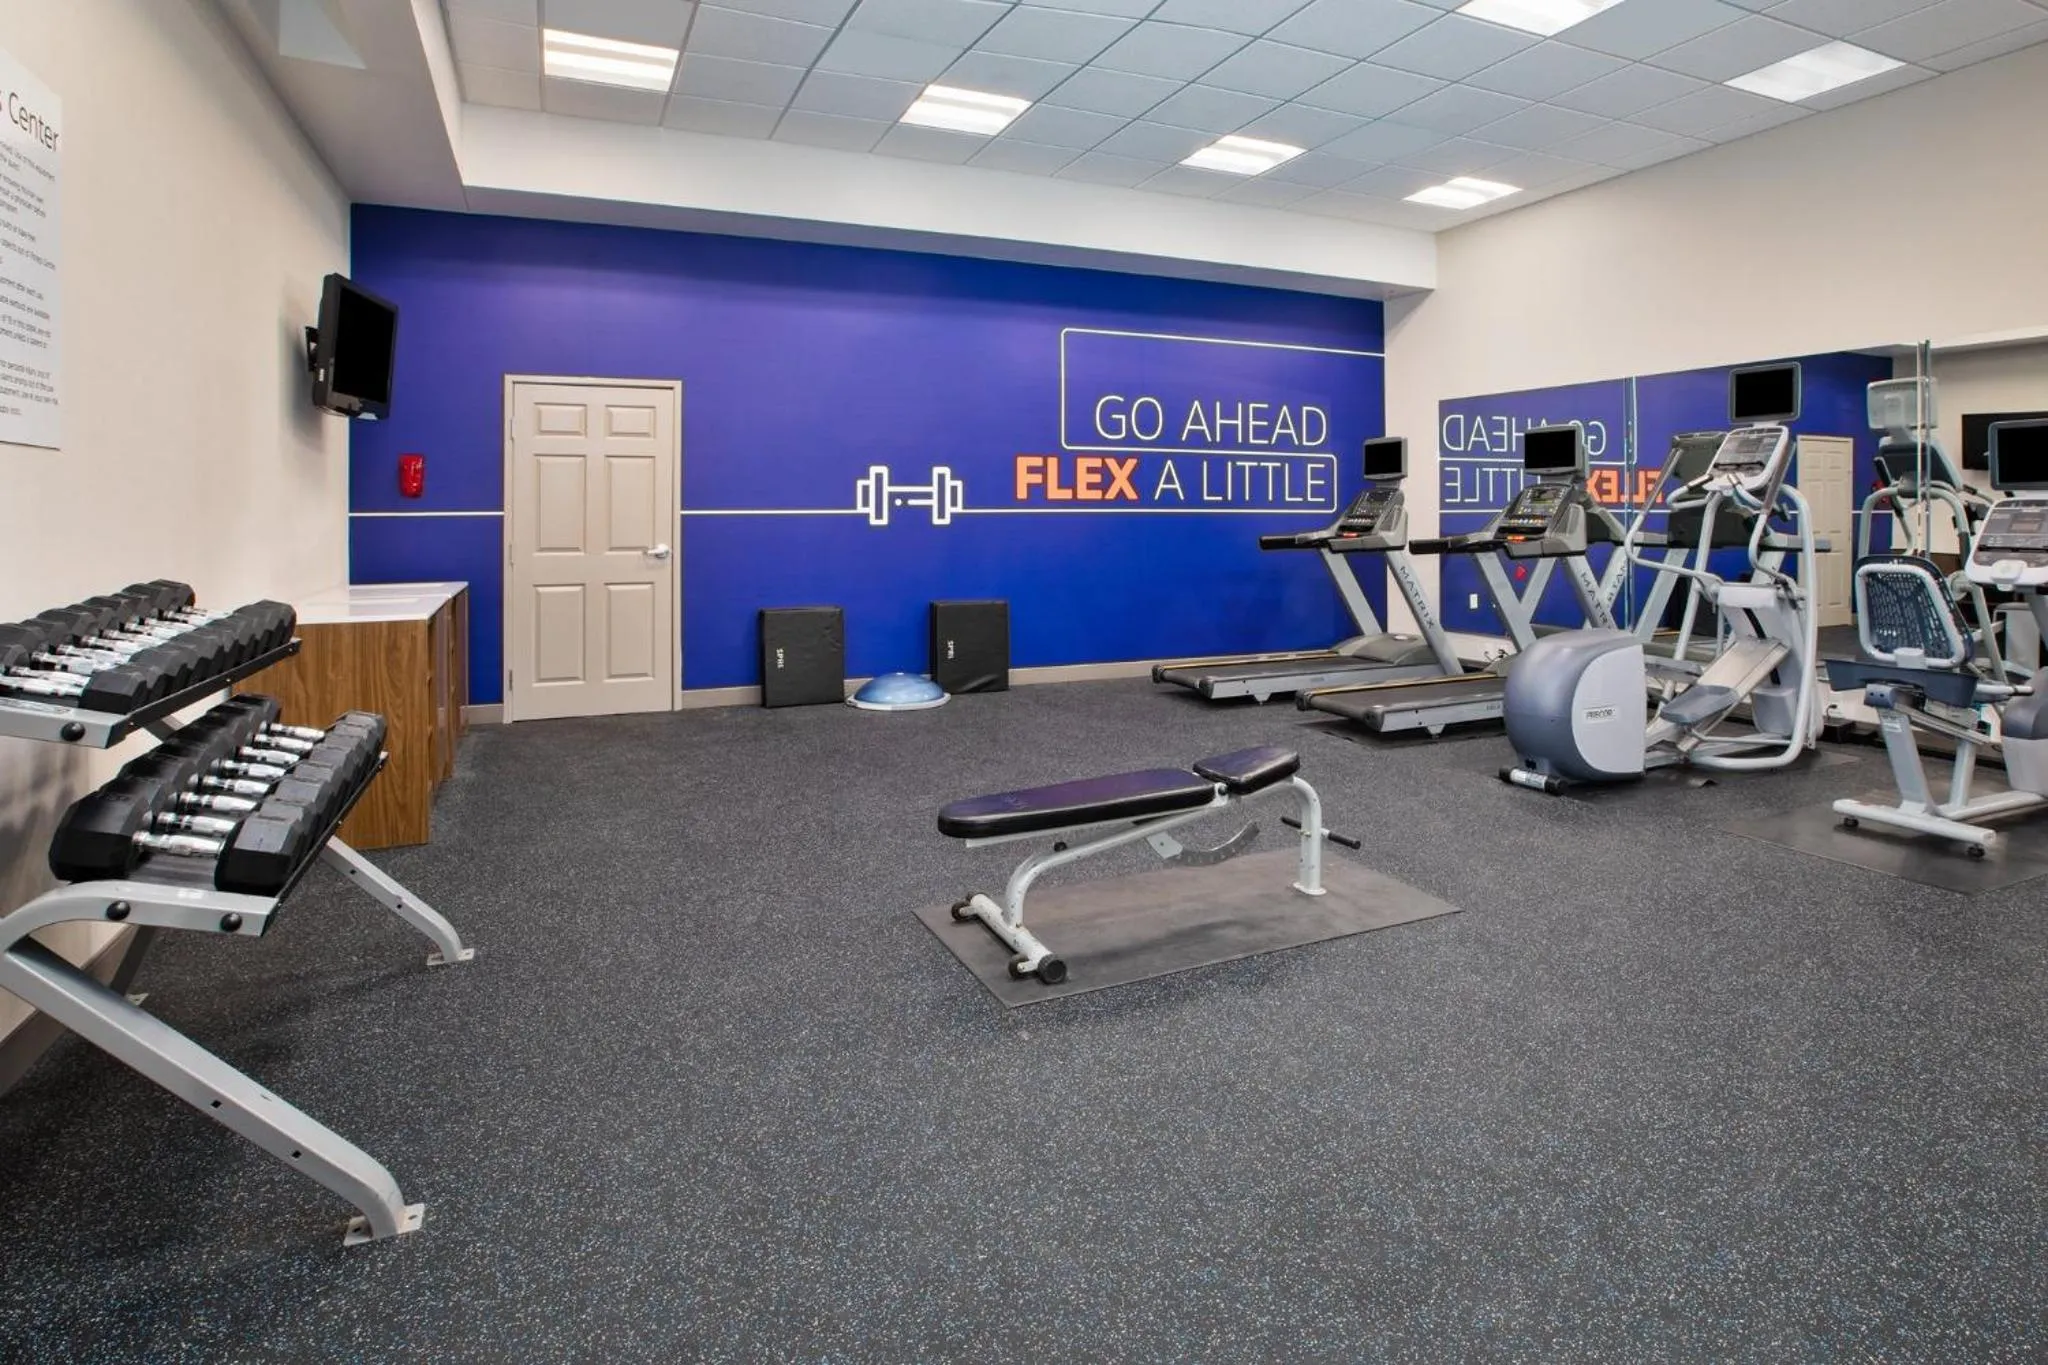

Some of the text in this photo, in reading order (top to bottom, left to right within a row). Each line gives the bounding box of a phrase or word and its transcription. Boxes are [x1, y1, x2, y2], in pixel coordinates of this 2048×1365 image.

[9, 92, 59, 152] Center
[1095, 394, 1327, 446] GO AHEAD
[1015, 455, 1325, 502] FLEX A LITTLE
[1400, 565, 1435, 630] MATRIX
